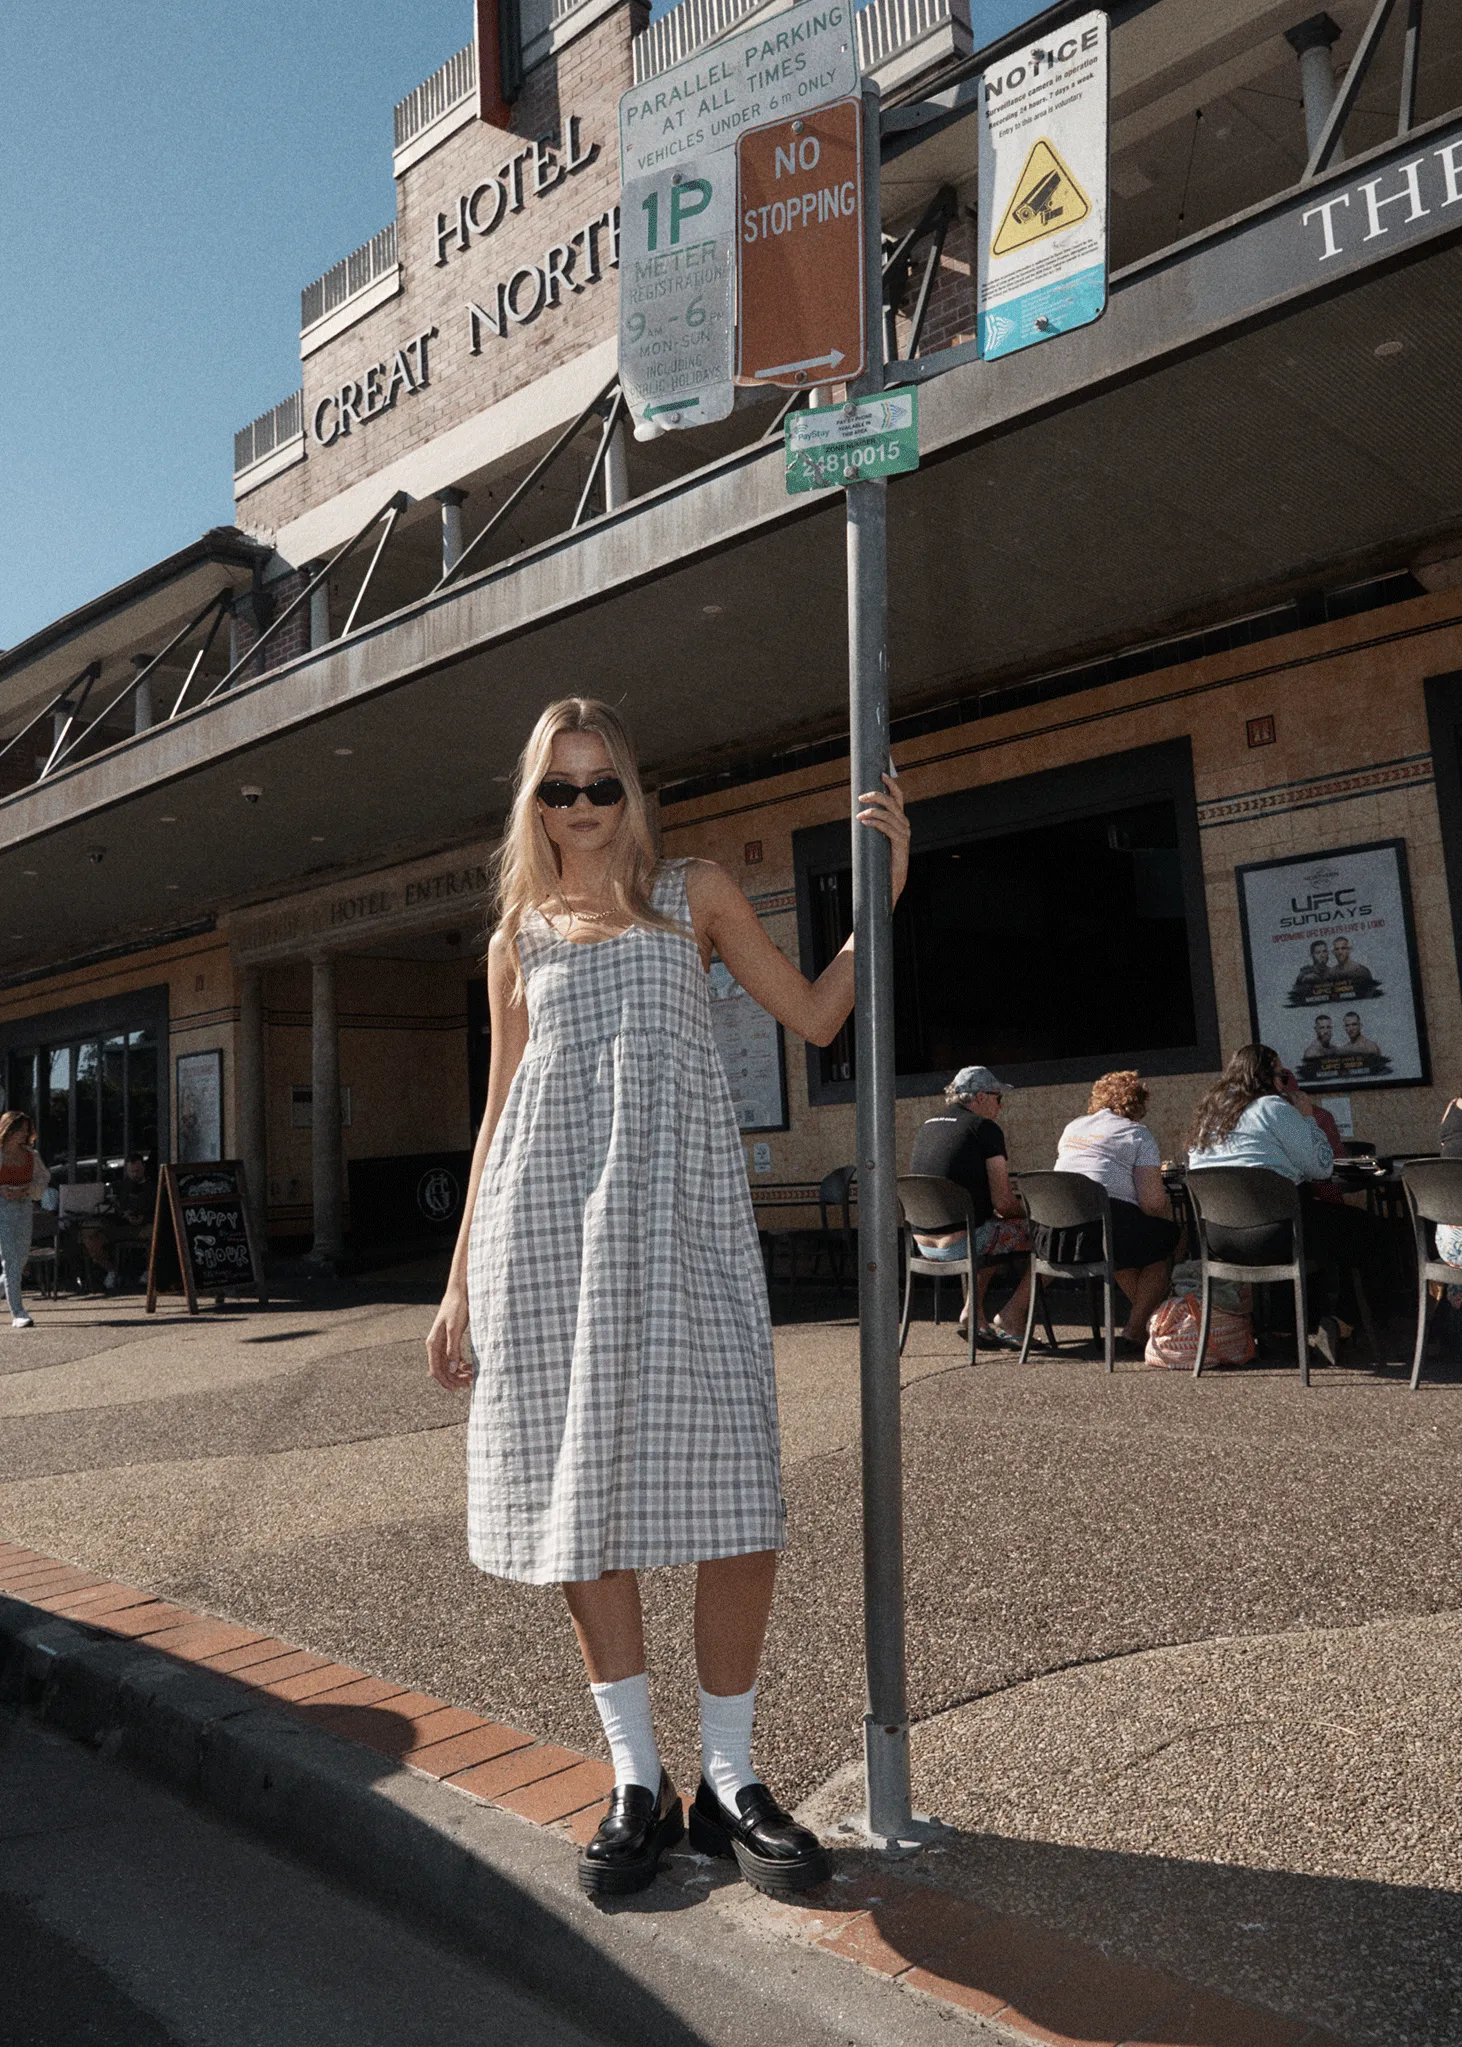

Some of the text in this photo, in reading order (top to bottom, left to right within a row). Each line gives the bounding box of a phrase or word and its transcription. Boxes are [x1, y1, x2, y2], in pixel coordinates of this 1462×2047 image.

[626, 6, 843, 126] PARALLEL PARKING
[985, 26, 1099, 102] NOTICE
[662, 52, 807, 134] AT ALL TIMES
[986, 56, 1098, 118] Surveillance camera in operation
[989, 110, 1018, 130] Recording
[1020, 105, 1028, 114] 24
[1055, 85, 1070, 97] days
[1077, 72, 1094, 85] week
[637, 129, 704, 170] VEHICLES
[711, 103, 761, 136] UNDER
[799, 68, 837, 97] ONLY
[999, 124, 1014, 138] Entry
[1055, 92, 1083, 110] voluntary
[775, 136, 820, 179] NO
[434, 115, 601, 268] HOTEL
[743, 181, 855, 243] STOPPING
[641, 178, 713, 251] 1P
[634, 240, 717, 283] METER
[629, 263, 724, 304] REGISTRATION
[639, 330, 711, 358] MON-SUN
[646, 354, 703, 379] INCLUDING
[671, 366, 720, 391] HOLIDAYS
[798, 428, 830, 440] PayStay
[825, 437, 876, 453] ZONE NUMBER
[329, 891, 391, 924] HOTEL
[1280, 905, 1373, 928] SUNDAYS
[1291, 888, 1357, 913] UFC
[185, 1208, 238, 1229] HAPPY
[205, 1245, 249, 1268] HOUR
